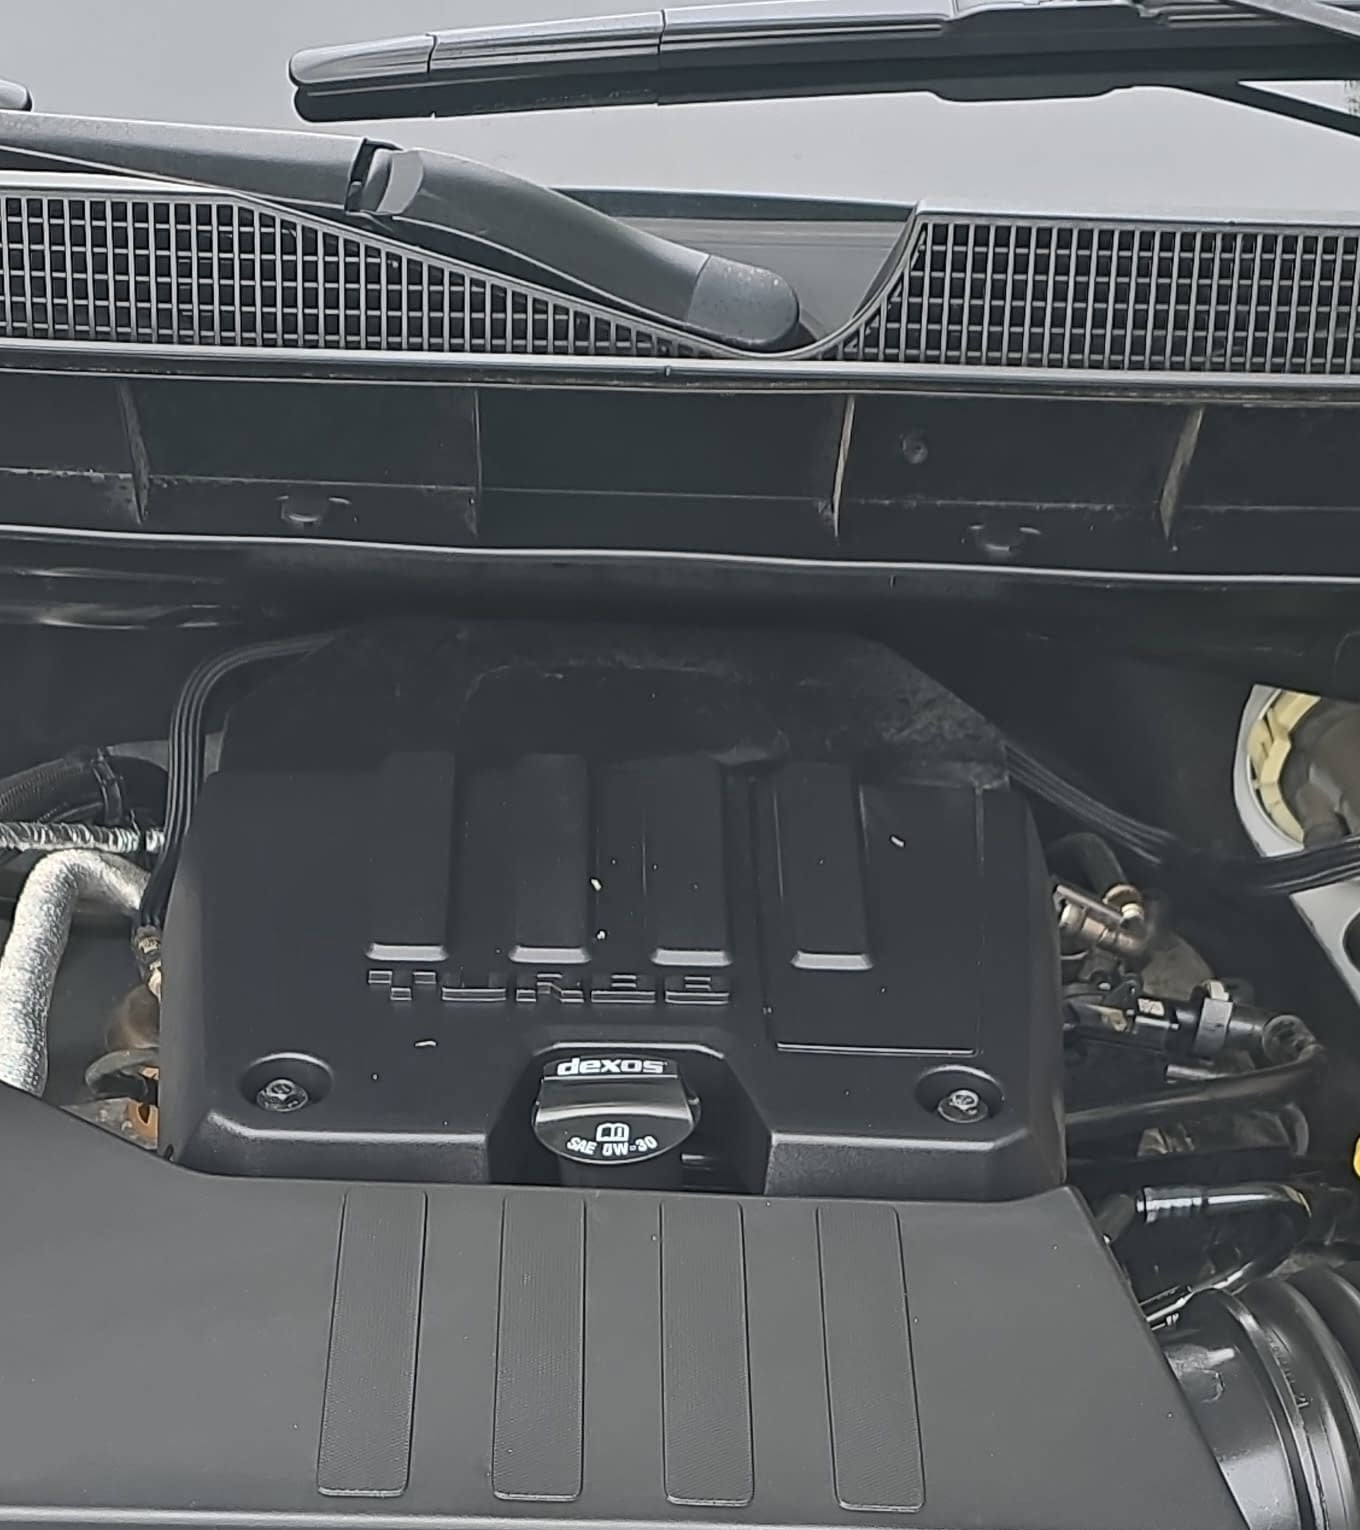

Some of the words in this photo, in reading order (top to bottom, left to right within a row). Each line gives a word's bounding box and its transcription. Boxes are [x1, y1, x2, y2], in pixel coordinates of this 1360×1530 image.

[557, 1057, 665, 1076] dexos
[566, 1136, 598, 1155] SAE
[602, 1135, 658, 1157] 0W-30
